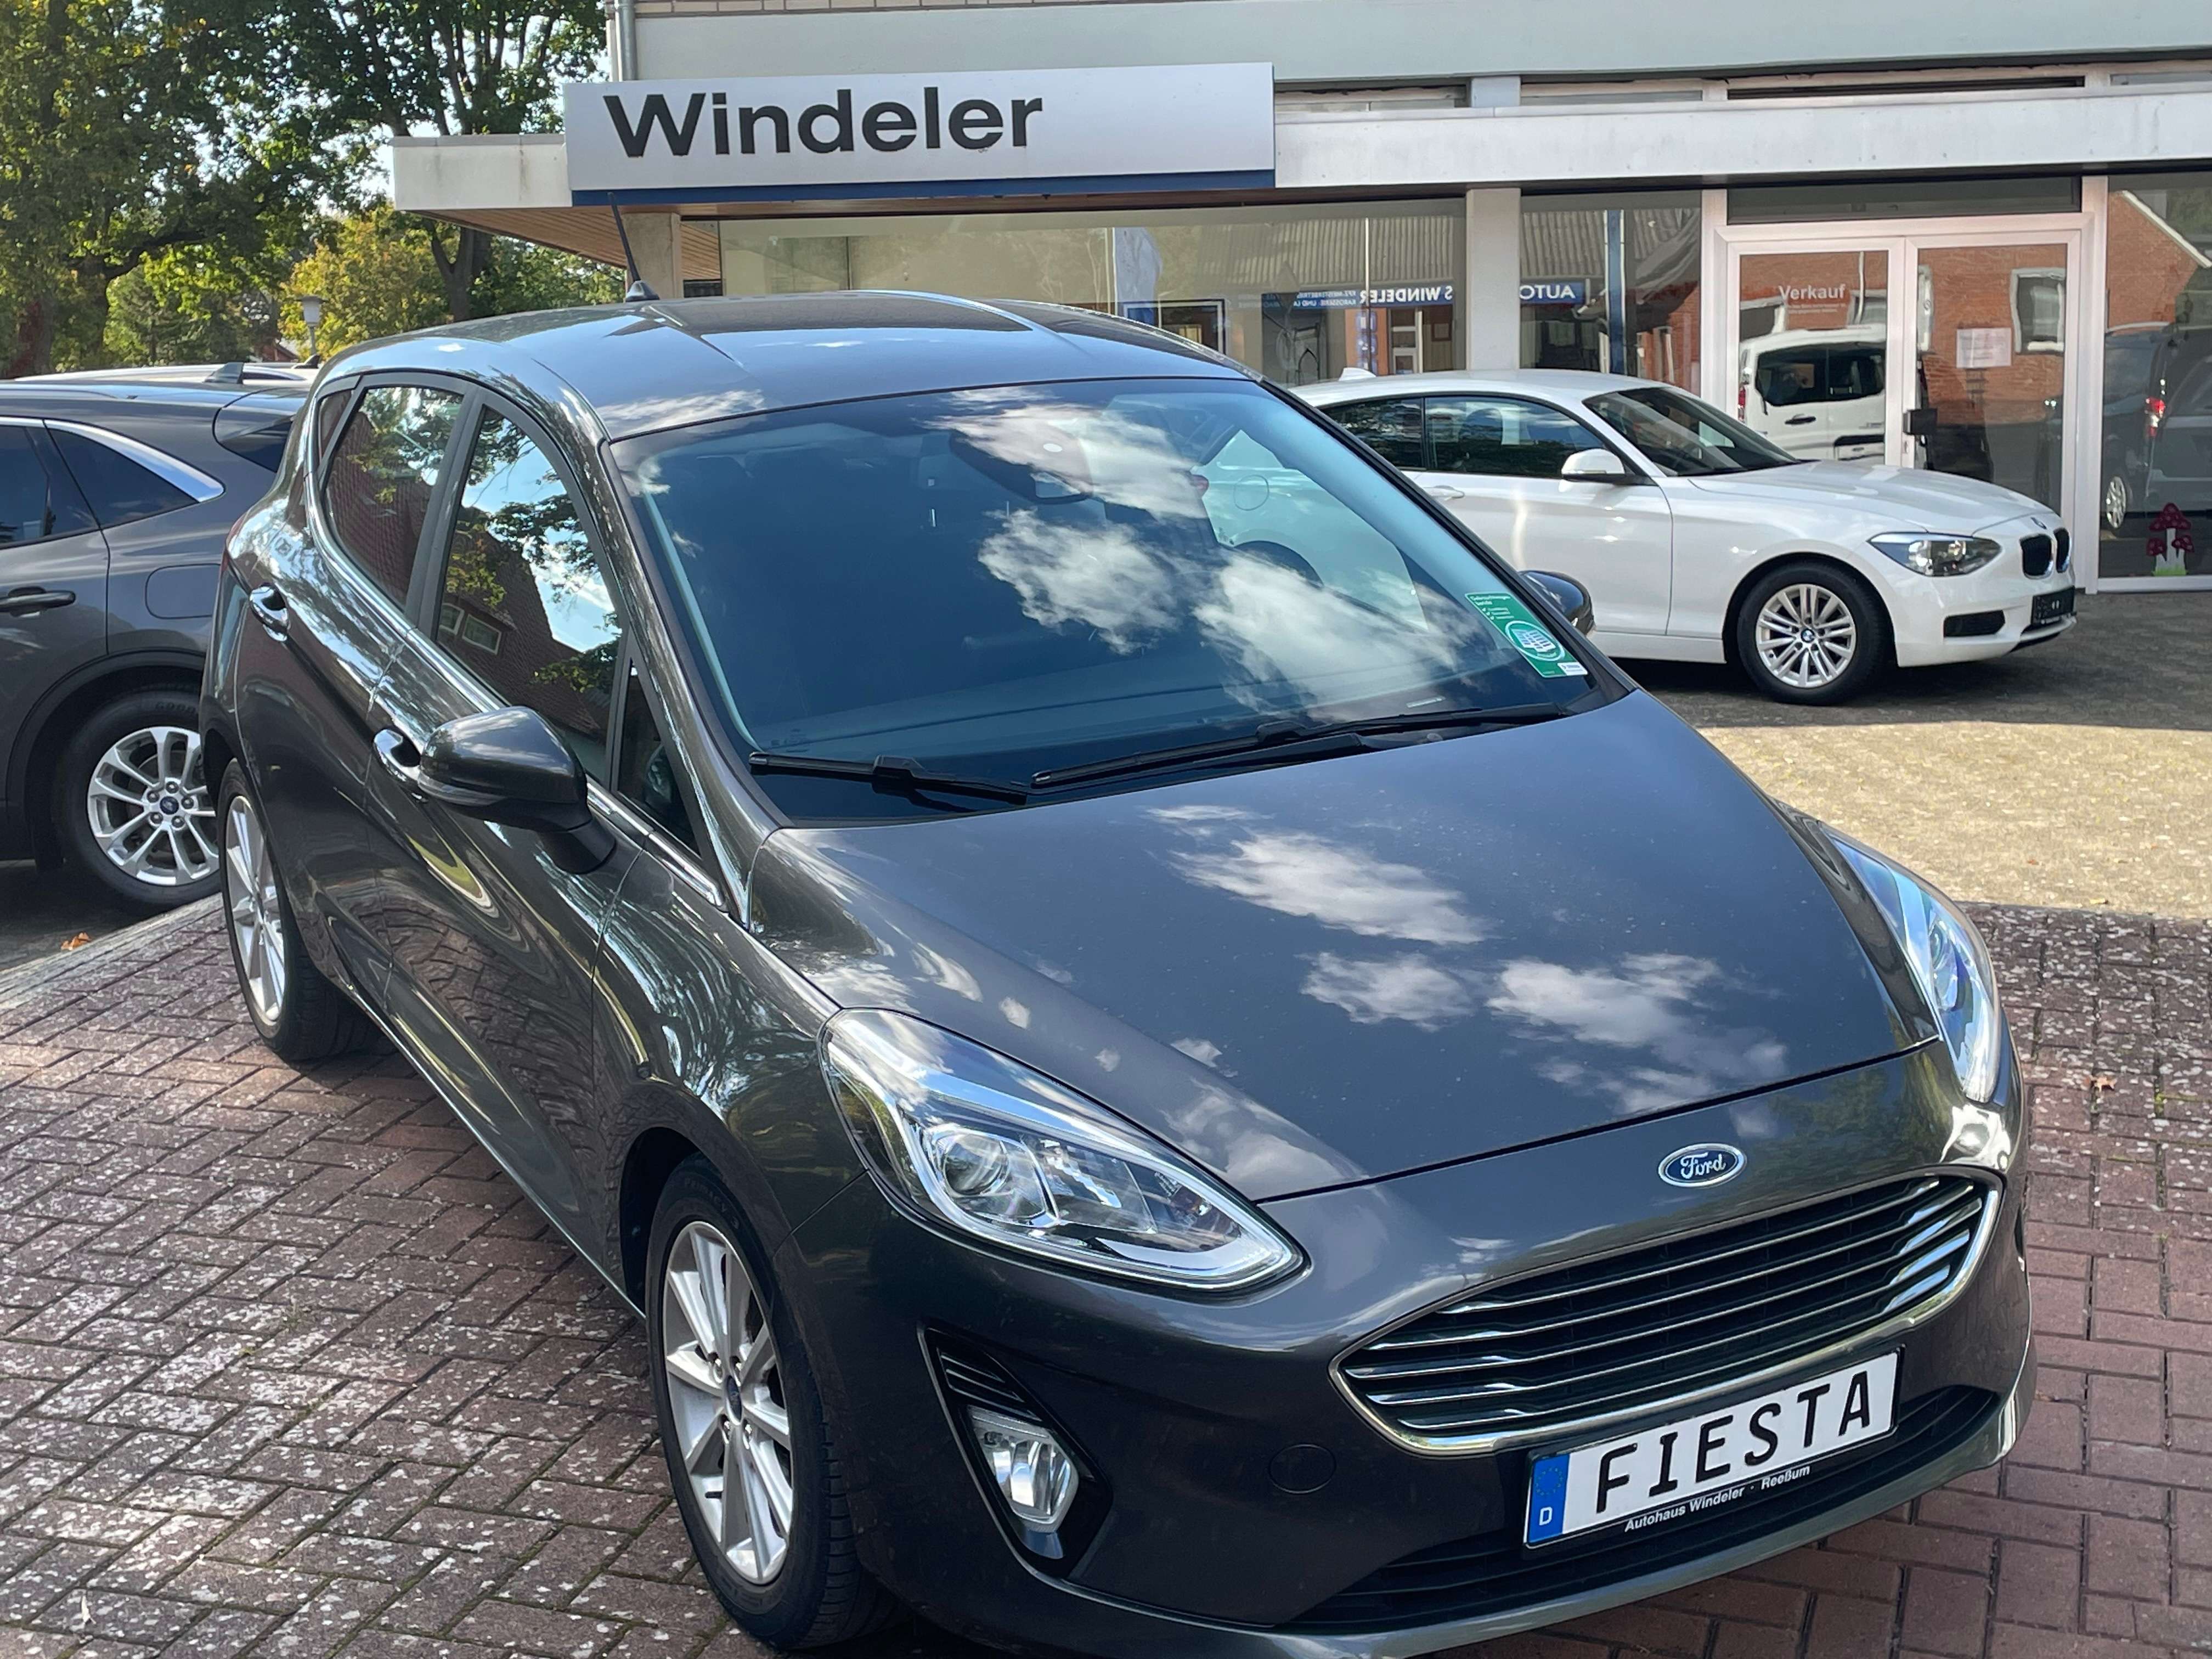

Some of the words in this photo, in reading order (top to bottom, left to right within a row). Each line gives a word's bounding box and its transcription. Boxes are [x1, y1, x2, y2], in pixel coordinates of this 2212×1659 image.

[603, 86, 1043, 158] Windeler
[1778, 283, 1847, 300] Verkauf
[1680, 1152, 1726, 1180] Ford
[1595, 1370, 1871, 1514] FIESTA
[1538, 1506, 1553, 1526] D
[1624, 1504, 1686, 1533] Autohaus
[1689, 1486, 1745, 1513] Windeler
